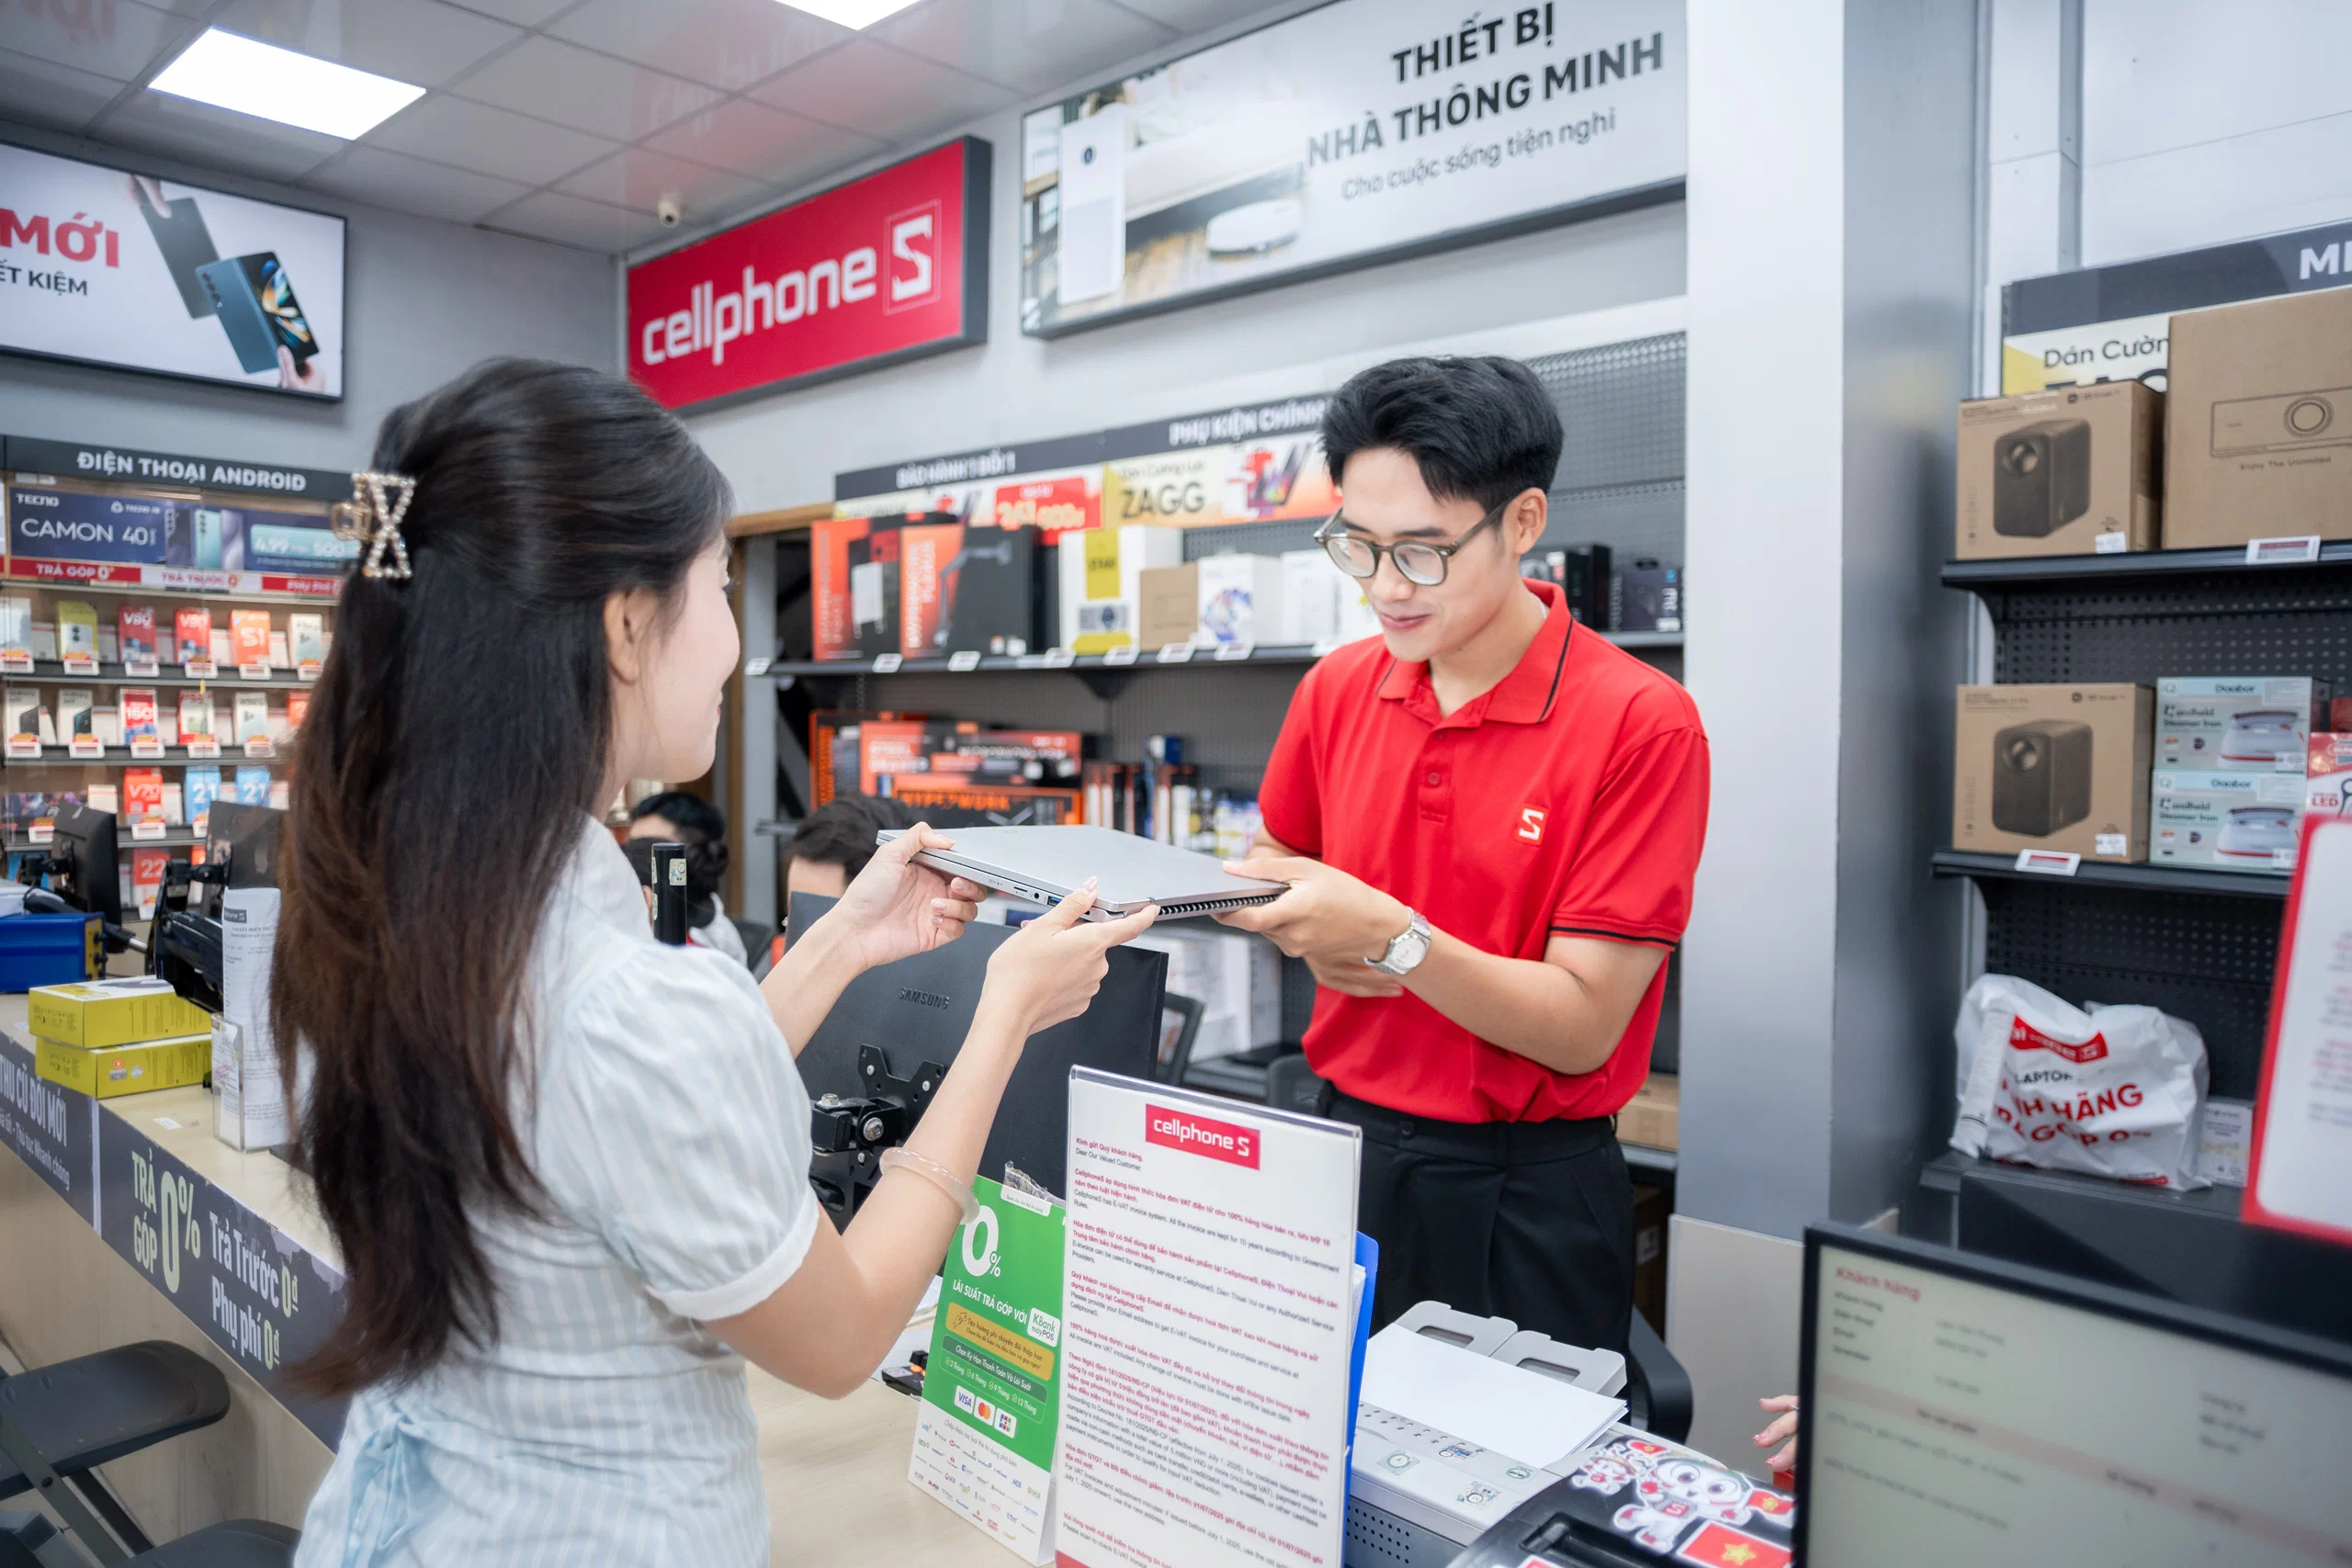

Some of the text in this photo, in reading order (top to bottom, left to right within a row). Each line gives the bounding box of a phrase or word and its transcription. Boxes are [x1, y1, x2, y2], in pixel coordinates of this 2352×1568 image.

[1391, 1, 1555, 84] THIẾT BỊ
[1307, 30, 1665, 167] NHÀ THÔNG MINH
[1341, 171, 1384, 200] Cho
[1443, 141, 1502, 175] sống
[1506, 127, 1554, 159] tiện
[0, 208, 119, 268] MỚI
[28, 268, 88, 297] KIỆM
[642, 213, 933, 367] cellphone S
[2043, 333, 2169, 369] Dán Cườn
[76, 450, 308, 491] ĐIỆN THOẠI ANDROID
[1120, 480, 1205, 521] ZAGG
[20, 516, 115, 544] CAMON
[192, 783, 217, 804] 21
[1519, 807, 1544, 841] S
[899, 987, 951, 1010] SAMSUNG
[1153, 1118, 1235, 1150] cellphone
[131, 1147, 157, 1214] TRẢ
[133, 1211, 158, 1275] GÓP
[161, 1170, 201, 1294] 0%
[209, 1211, 232, 1273] Trả
[233, 1228, 280, 1309] Trước
[211, 1275, 237, 1349] Phụ
[240, 1303, 263, 1363] phí
[965, 1285, 981, 1302] SUẤT
[982, 1293, 995, 1310] TRẢ
[997, 1301, 1012, 1316] GÓP
[1014, 1308, 1028, 1325] VỚI
[1033, 1313, 1056, 1333] KBank
[958, 1392, 972, 1407] VISA
